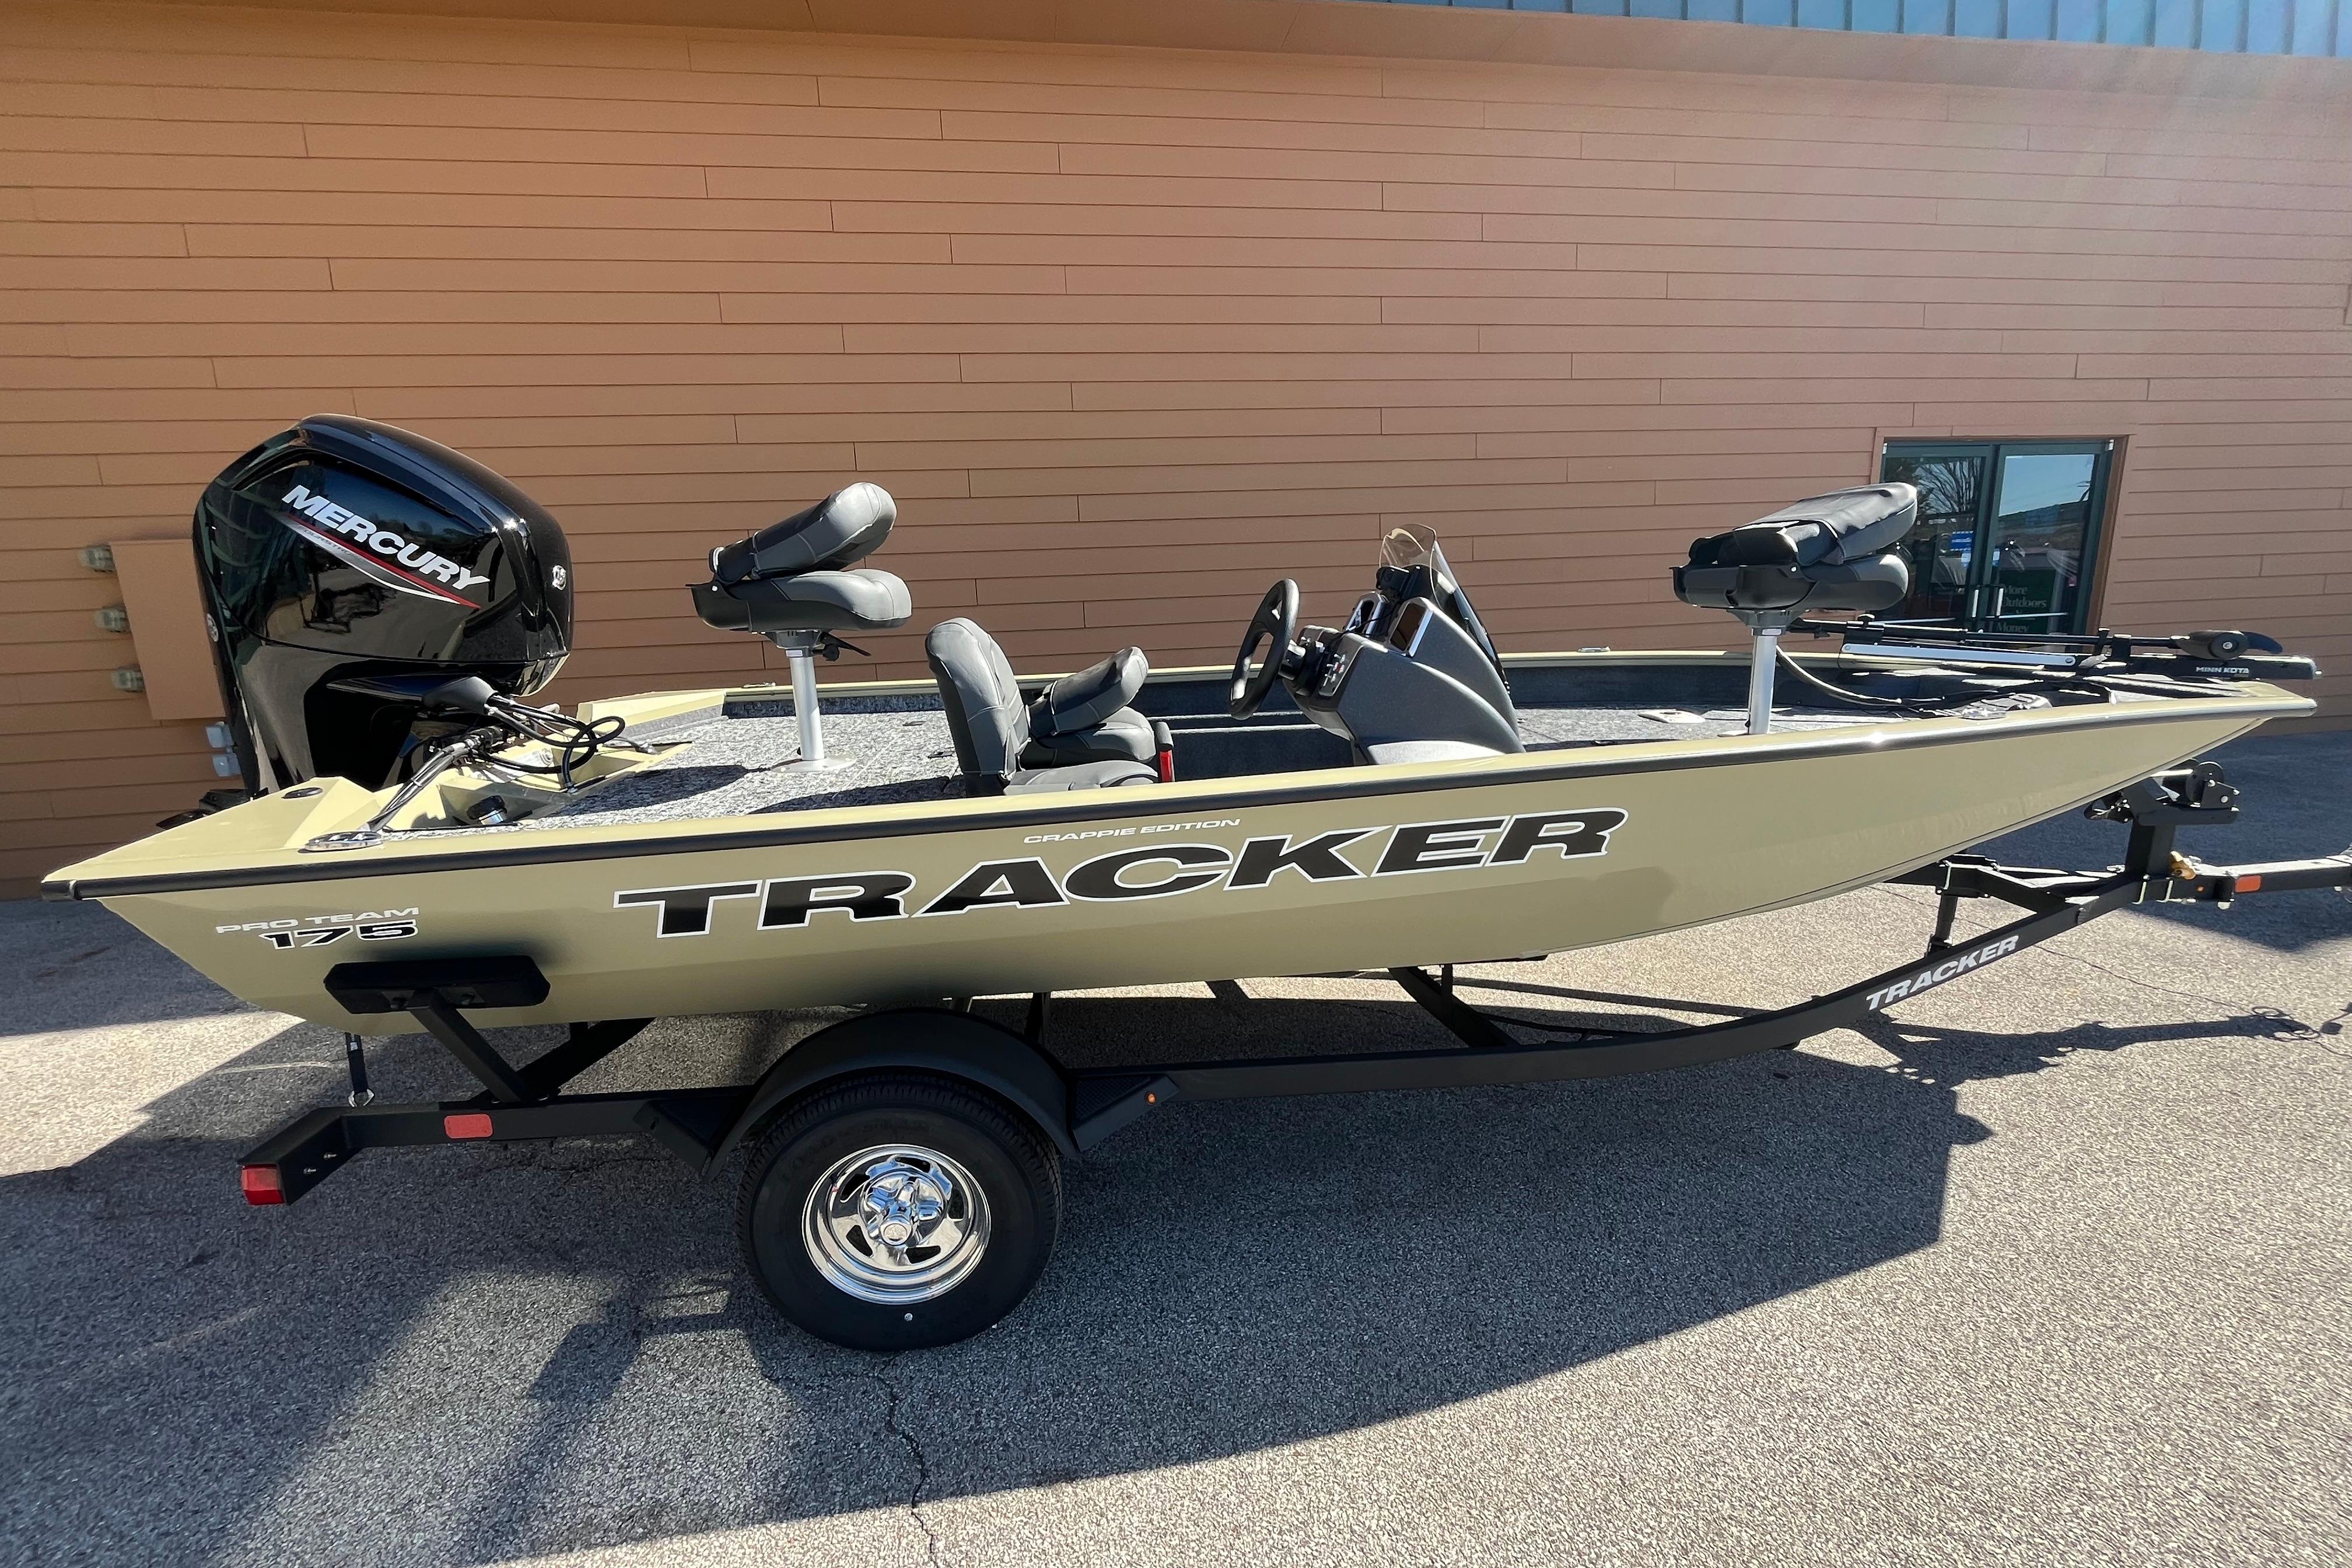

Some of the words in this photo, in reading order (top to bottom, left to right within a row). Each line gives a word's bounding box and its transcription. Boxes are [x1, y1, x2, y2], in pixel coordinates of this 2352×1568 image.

[282, 485, 490, 590] MERCURY
[1024, 827, 1137, 844] CRAPPIE
[1140, 818, 1241, 835] EDITION
[613, 807, 1629, 939] TRACKER
[215, 919, 299, 934] PRO
[304, 907, 419, 925] TEAM
[258, 919, 419, 950] 175
[1866, 935, 2020, 1011] TRACKER
